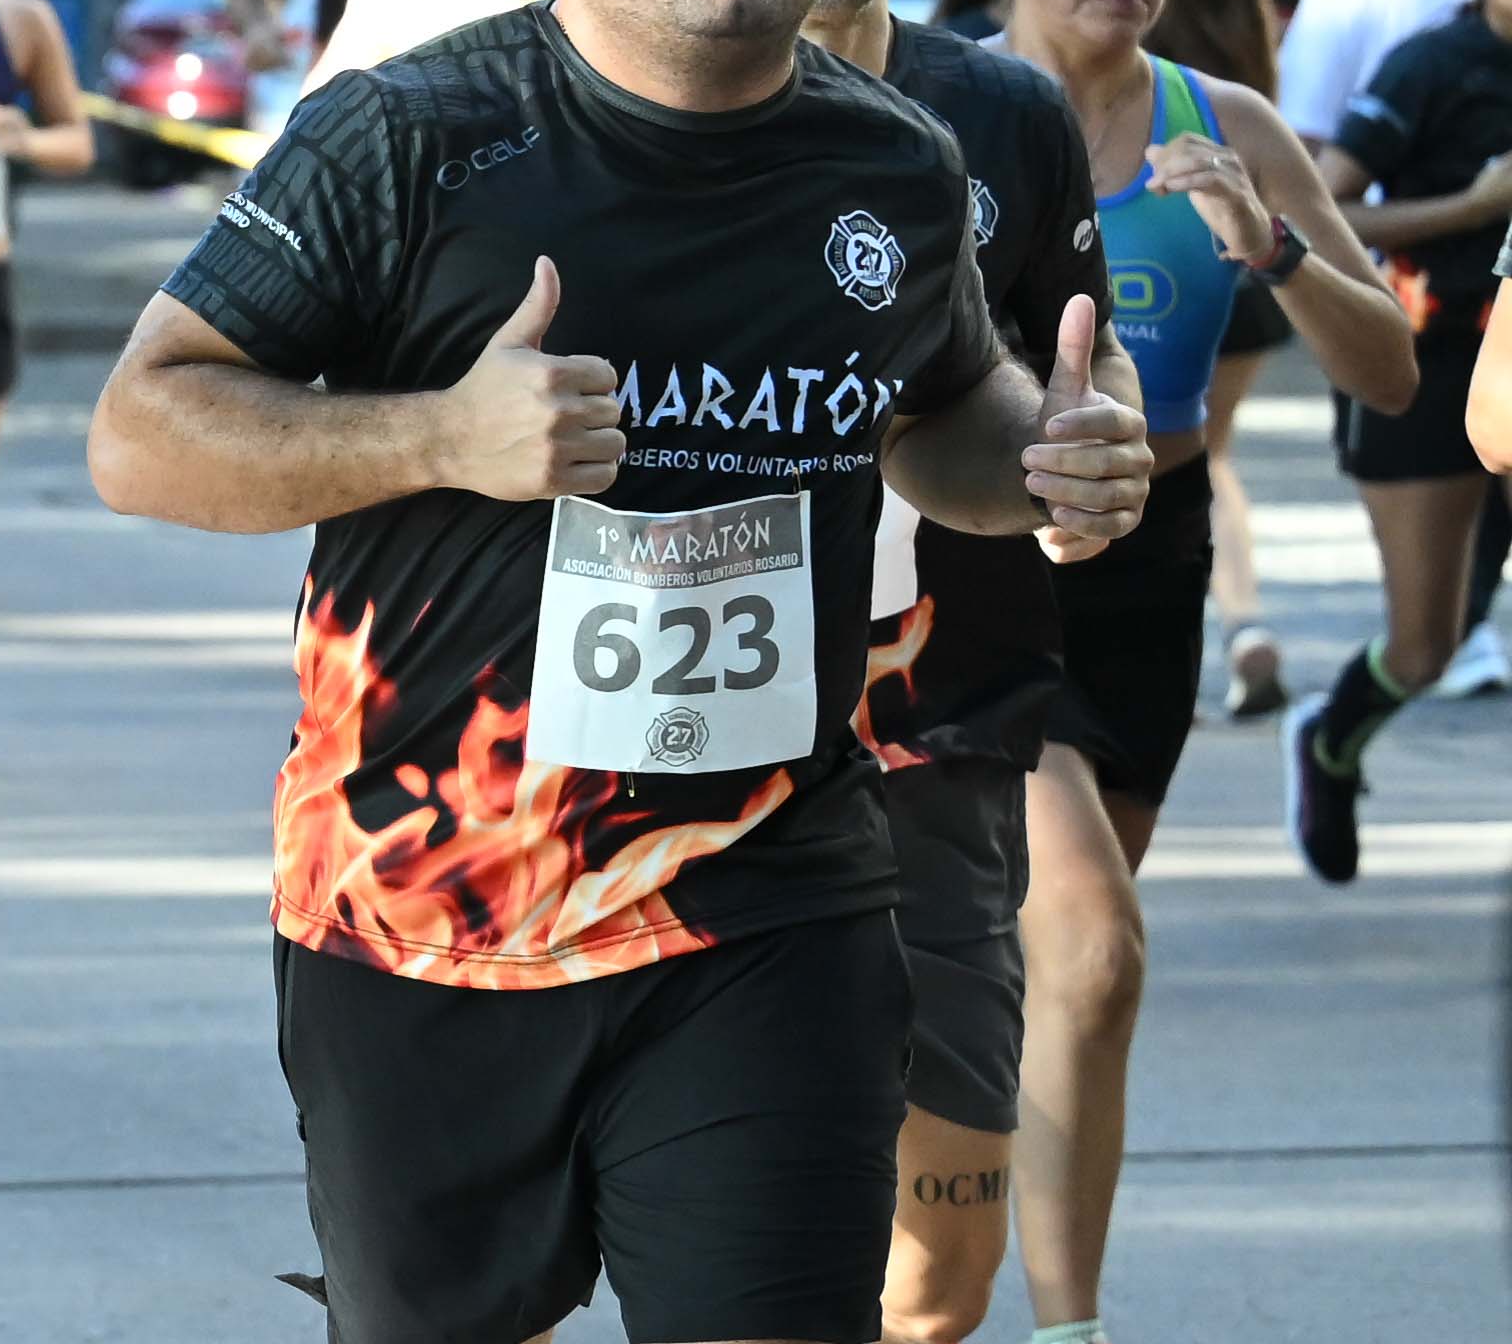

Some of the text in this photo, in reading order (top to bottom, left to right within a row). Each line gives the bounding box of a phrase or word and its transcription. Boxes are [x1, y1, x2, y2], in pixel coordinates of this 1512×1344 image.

[854, 239, 884, 272] 27
[630, 512, 771, 566] MARATÓN
[633, 570, 695, 588] BOMBEROS
[697, 559, 754, 584] VOLUNTARIOS
[755, 552, 799, 572] ROSARIO
[573, 594, 781, 696] 623
[666, 725, 692, 746] 27
